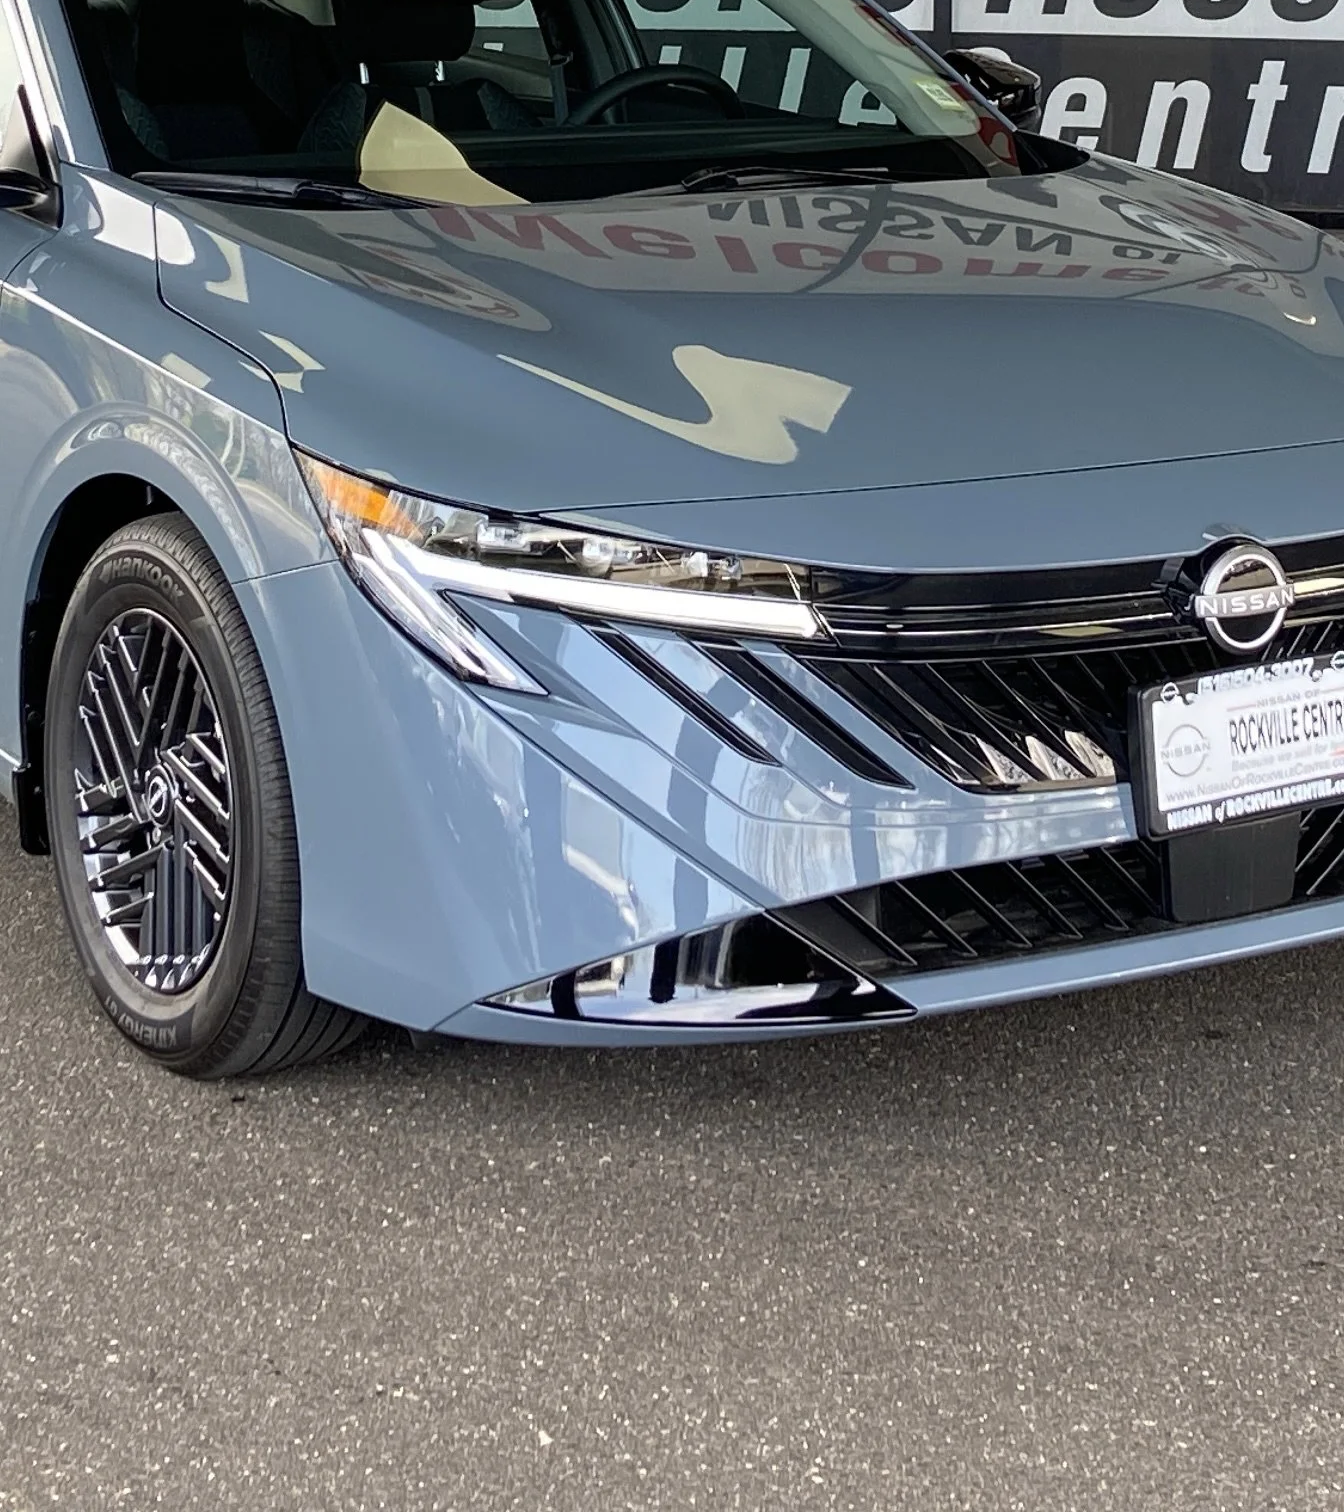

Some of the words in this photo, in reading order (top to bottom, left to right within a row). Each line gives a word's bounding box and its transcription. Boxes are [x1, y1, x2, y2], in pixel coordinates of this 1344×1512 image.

[1200, 585, 1295, 615] NISSAN
[1257, 692, 1301, 707] NISSAN
[1228, 707, 1300, 756] ROCKVILLE
[1161, 741, 1212, 759] NISSAN
[1167, 804, 1213, 830] NISSAN
[1215, 801, 1226, 822] of
